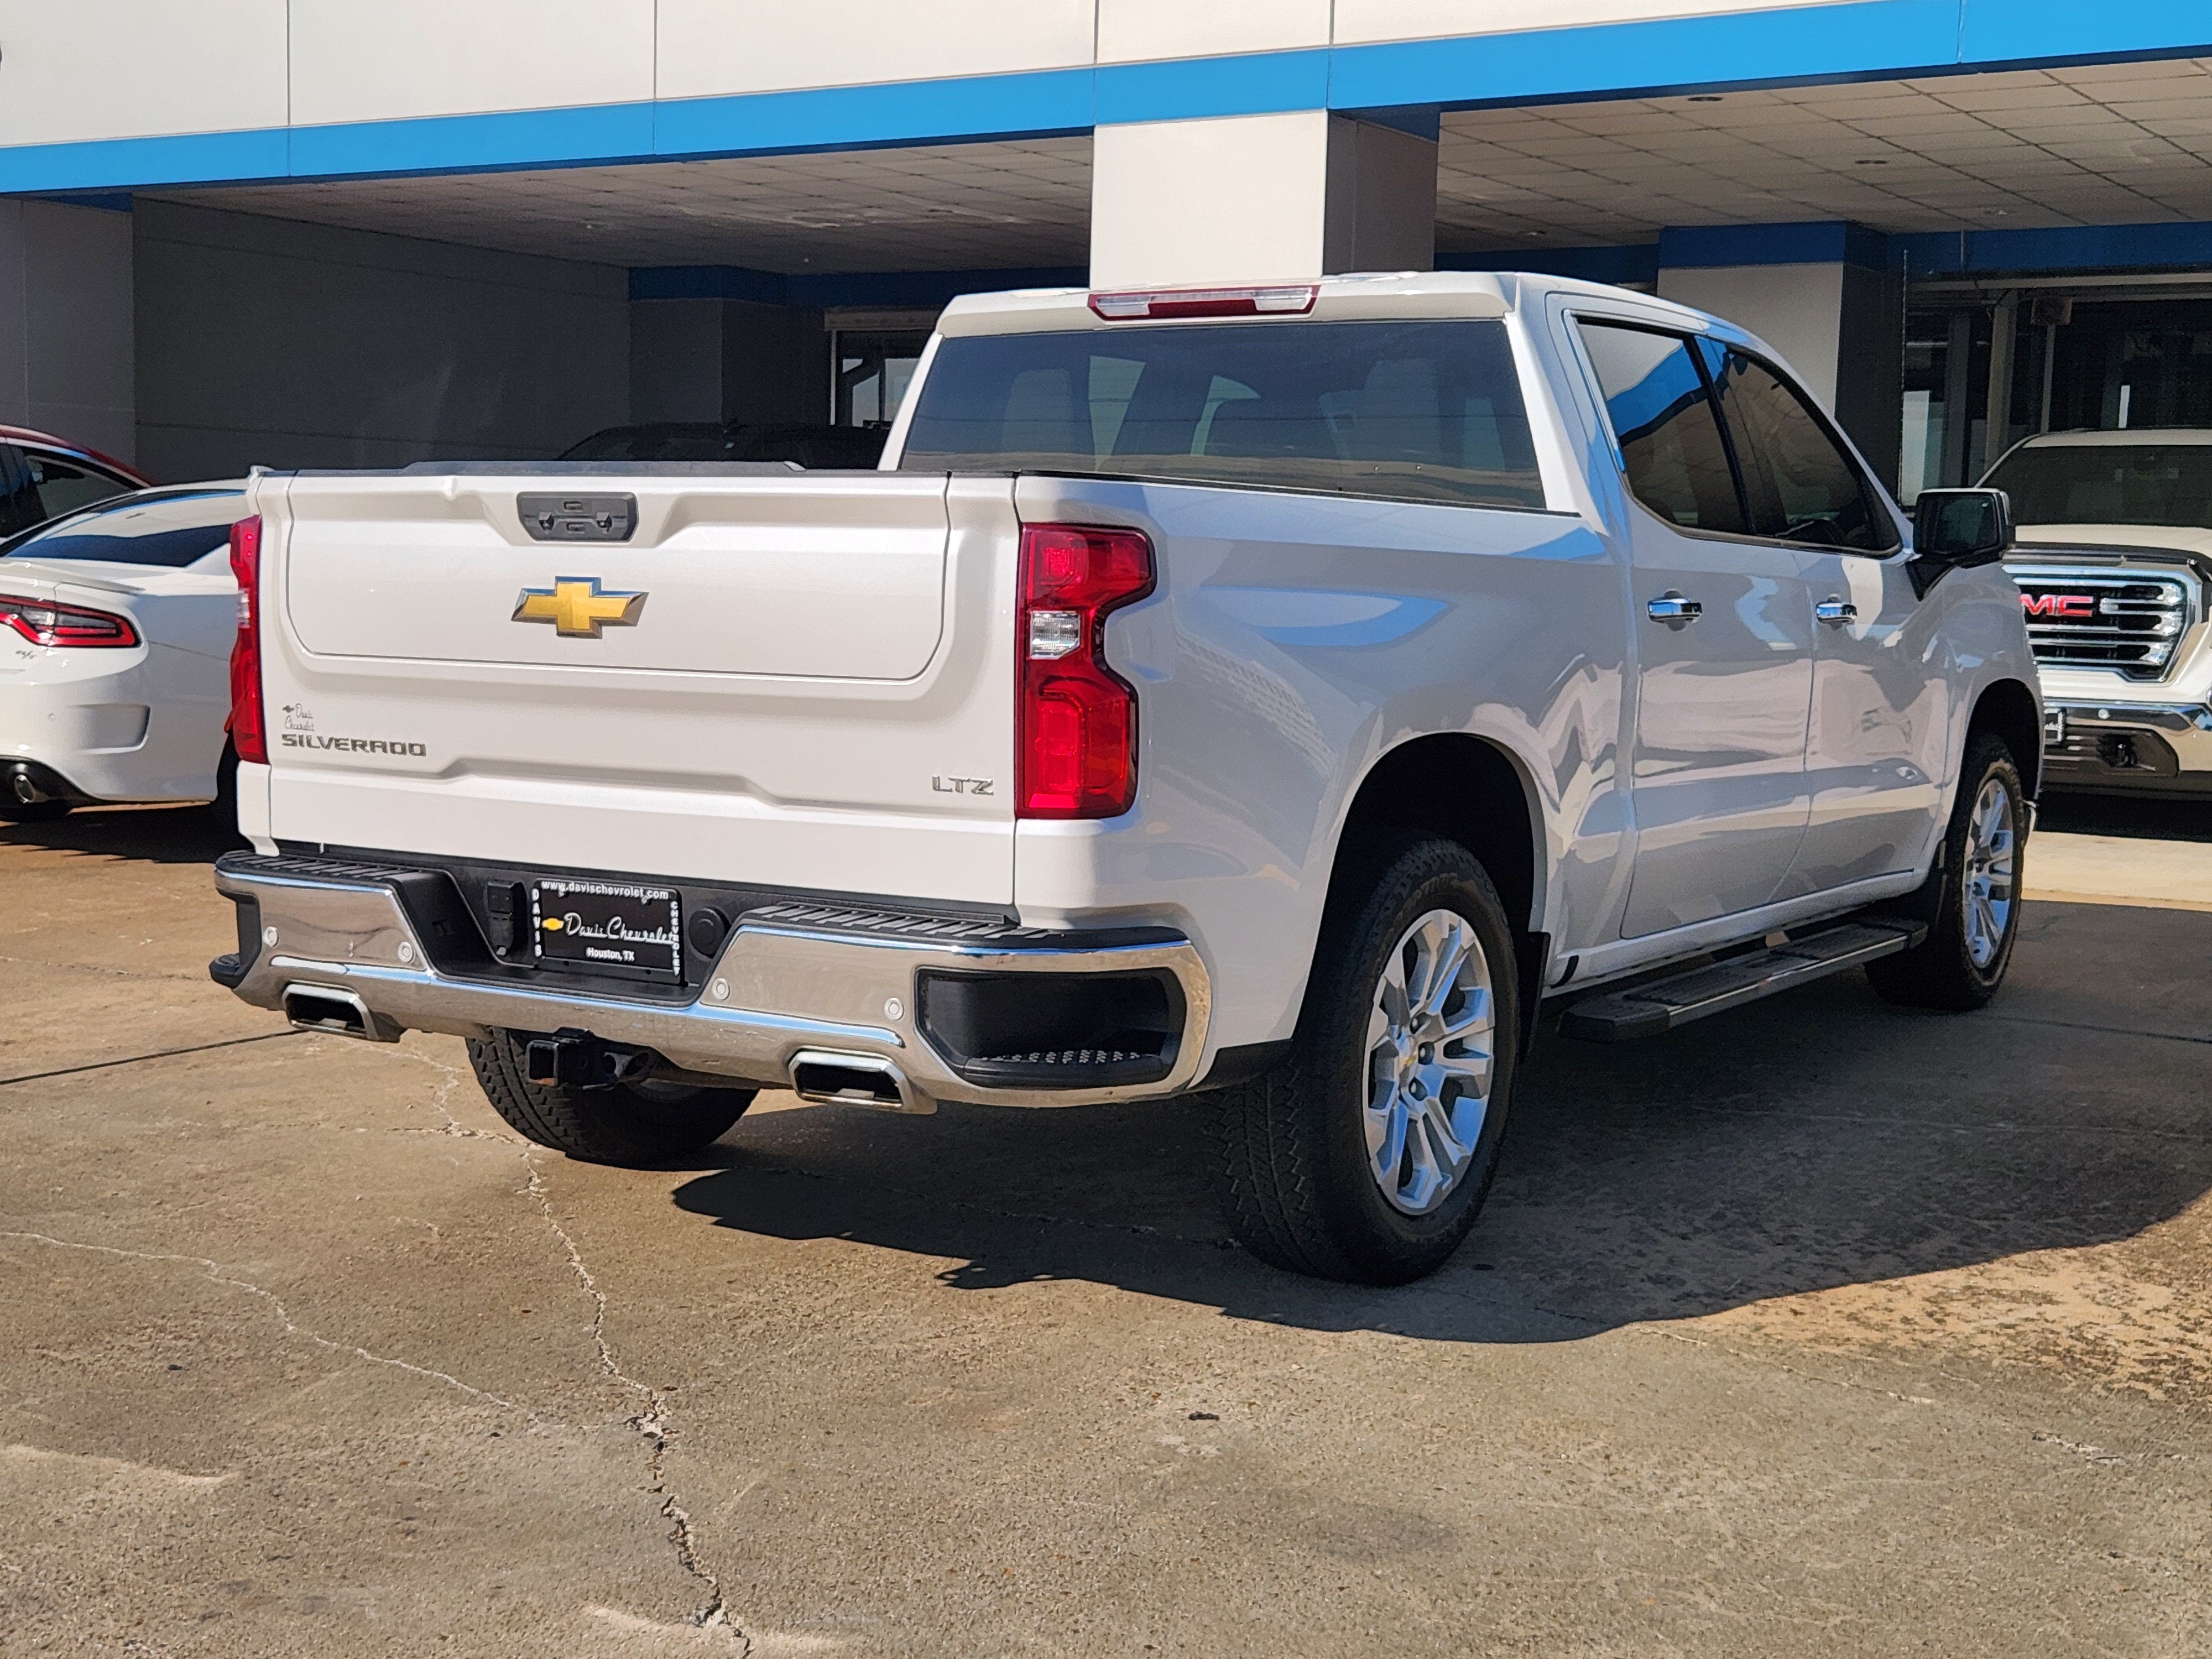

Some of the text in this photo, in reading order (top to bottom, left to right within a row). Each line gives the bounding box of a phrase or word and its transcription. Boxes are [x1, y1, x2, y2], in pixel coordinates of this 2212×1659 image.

[2019, 593, 2094, 617] MC
[281, 733, 427, 757] SILVERADO
[932, 775, 994, 796] LTZ
[541, 880, 669, 900] www.davischevrolet.com
[531, 888, 542, 957] DAVIS
[564, 912, 675, 945] Davis Chevrolet
[670, 900, 681, 977] CHEVROLET
[586, 947, 635, 962] Houston, TX
